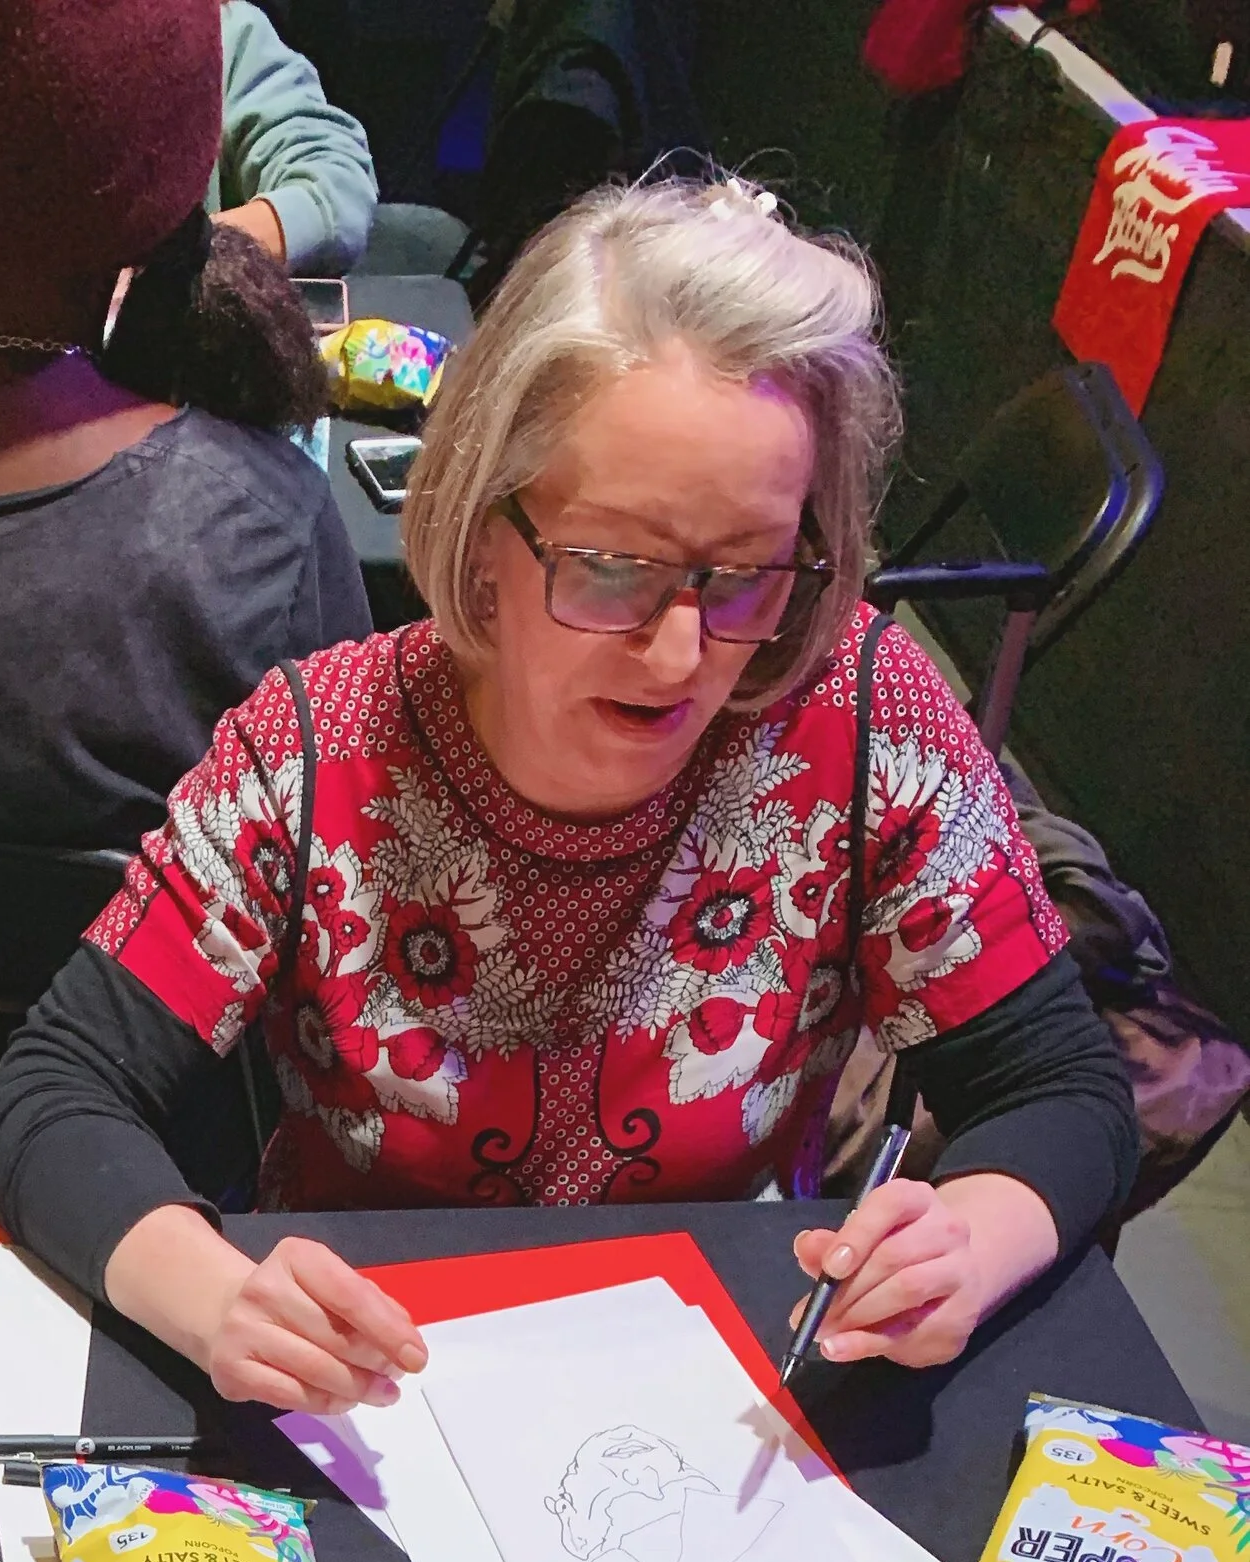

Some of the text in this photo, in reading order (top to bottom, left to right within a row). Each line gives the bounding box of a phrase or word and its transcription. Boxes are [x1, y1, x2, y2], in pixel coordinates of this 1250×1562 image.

[1052, 1447, 1085, 1462] 135
[1116, 1476, 1174, 1502] POPCORN
[1066, 1473, 1211, 1536] SWEET & SALTY
[117, 1532, 149, 1549] 135
[184, 1540, 239, 1558] POPCORN
